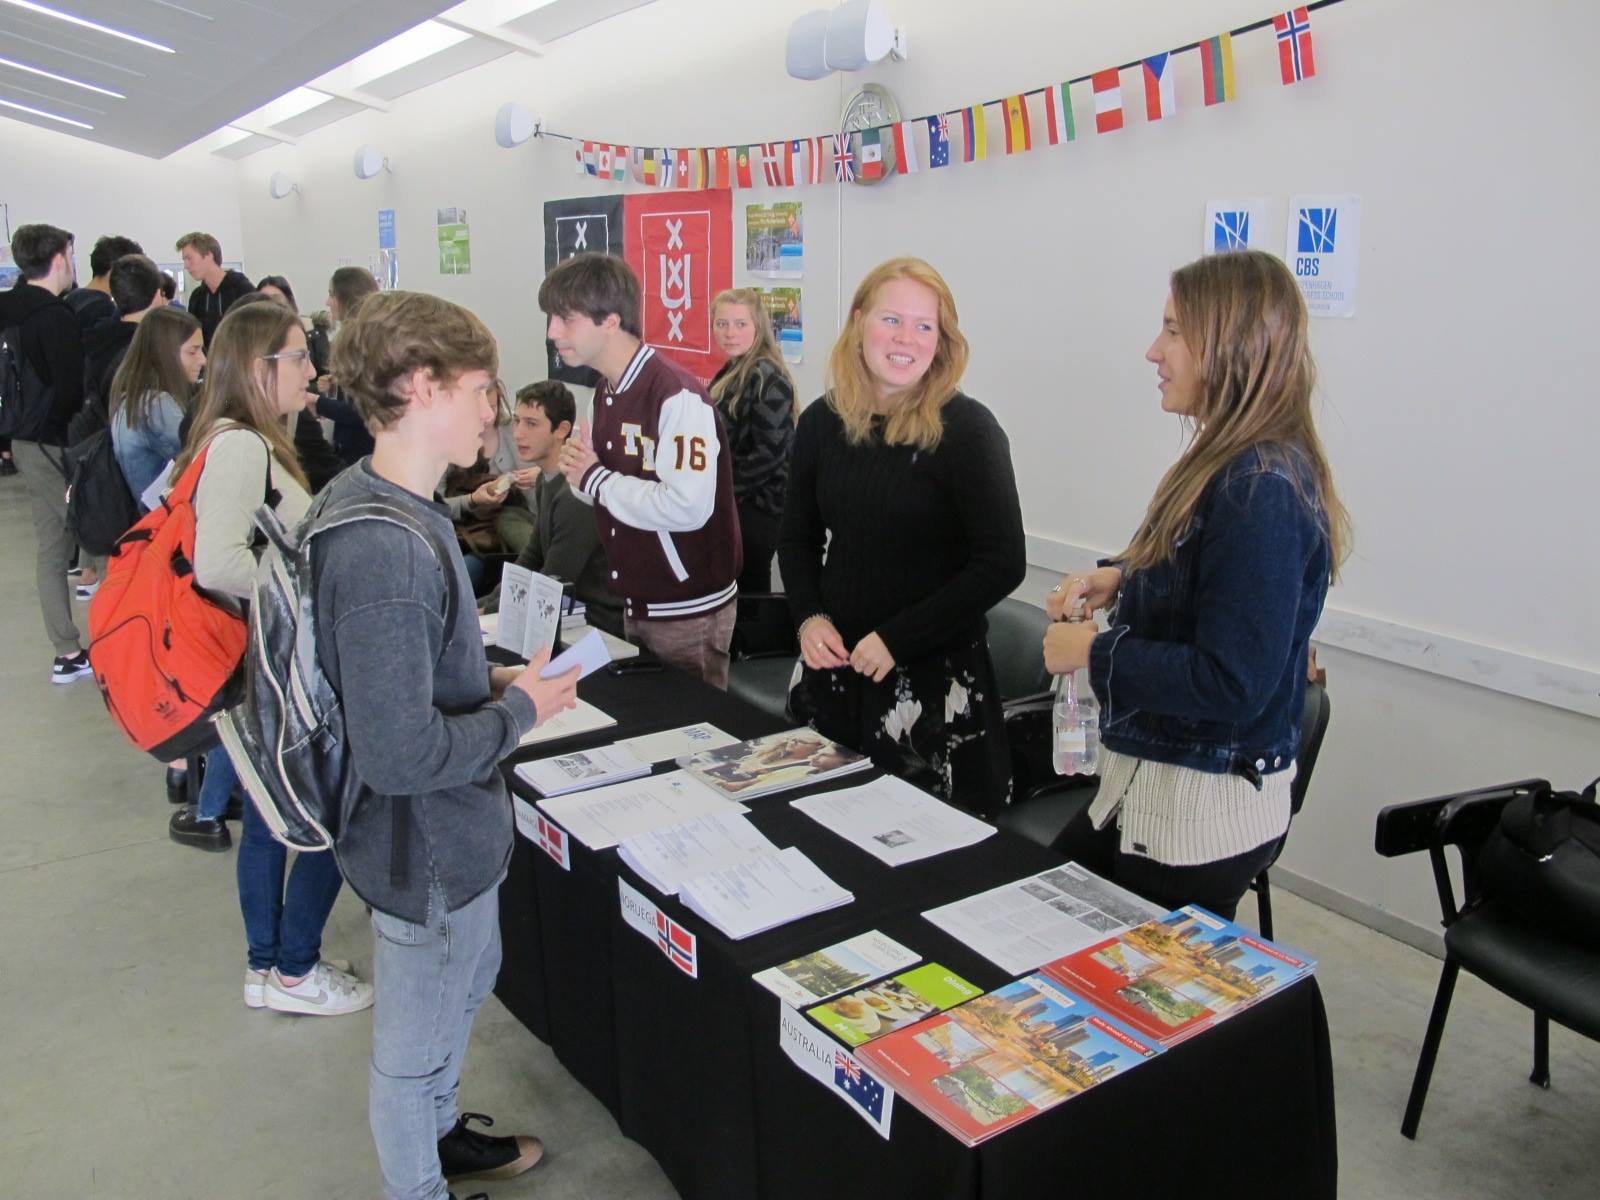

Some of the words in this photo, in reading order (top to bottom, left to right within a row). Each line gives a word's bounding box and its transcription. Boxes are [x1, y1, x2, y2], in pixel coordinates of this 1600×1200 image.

[1296, 257, 1320, 276] CBS
[674, 435, 706, 471] 16
[620, 888, 656, 928] NORUEGA
[943, 975, 973, 997] Dining
[781, 1017, 833, 1069] AUSTRALIA
